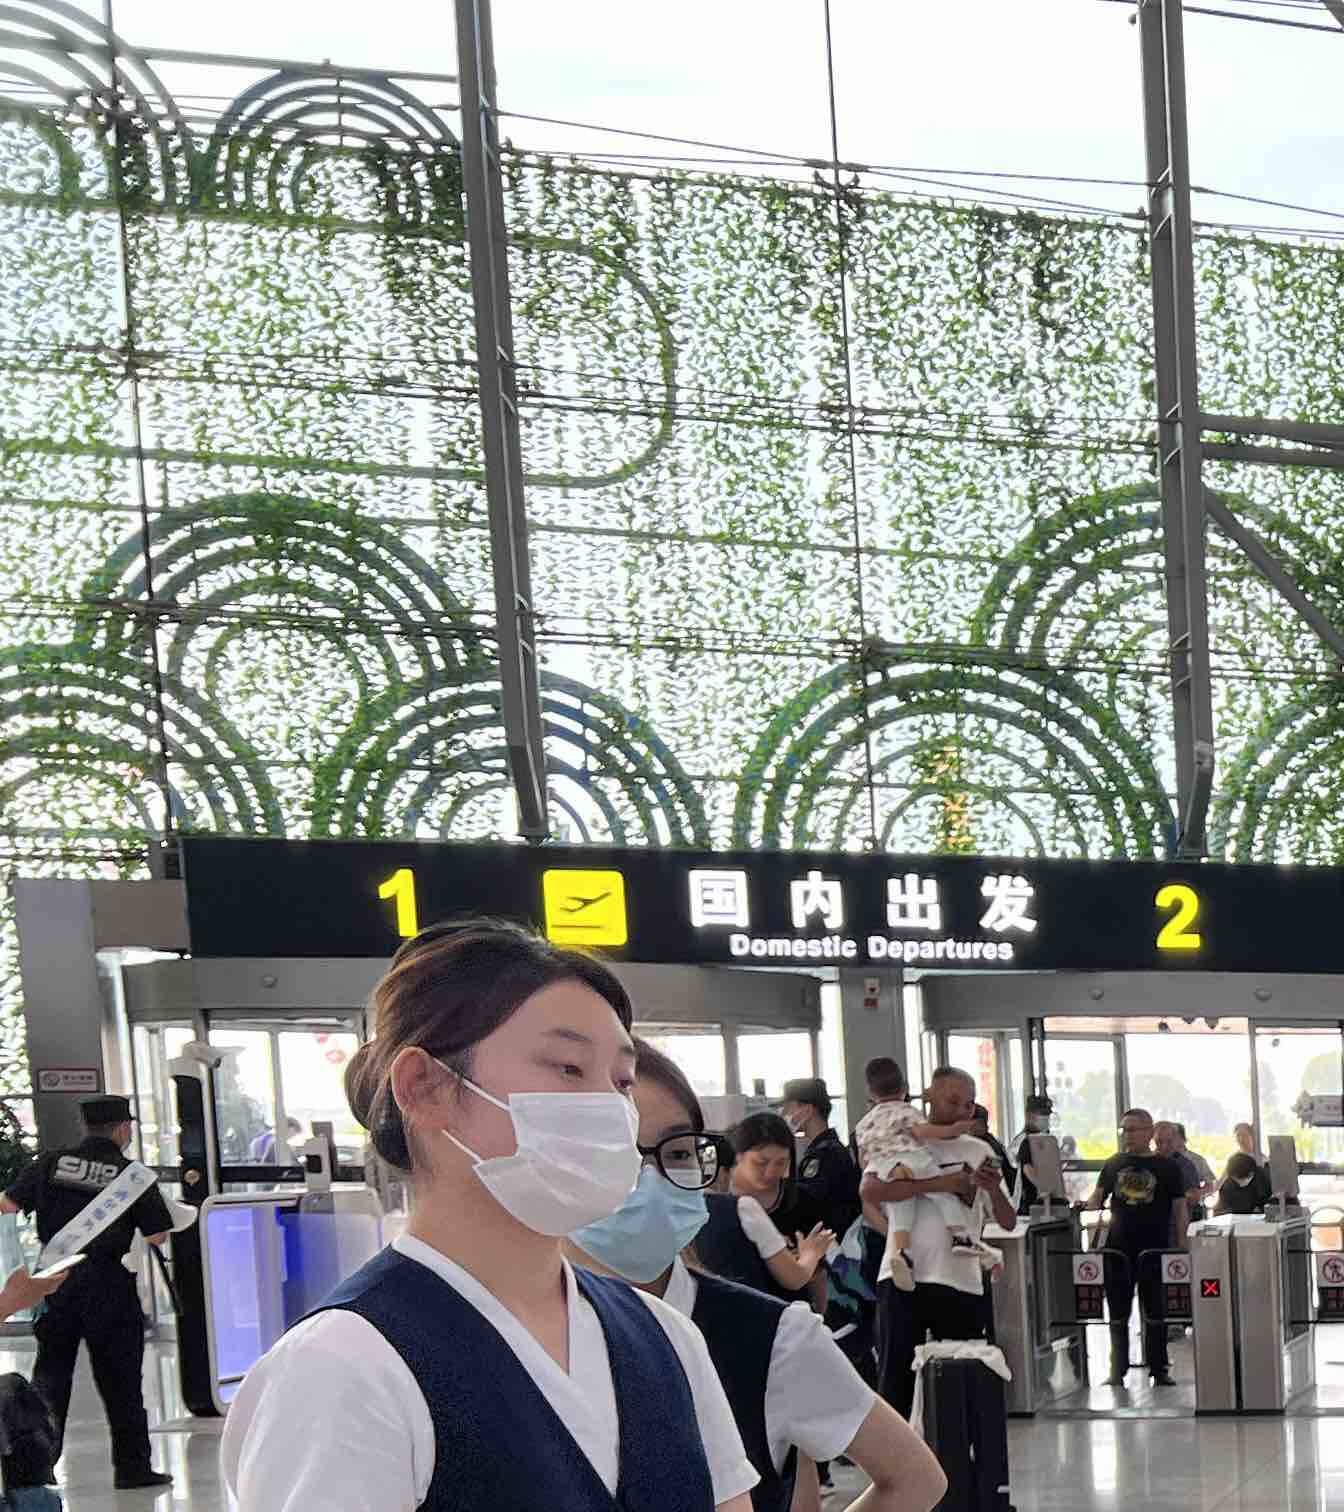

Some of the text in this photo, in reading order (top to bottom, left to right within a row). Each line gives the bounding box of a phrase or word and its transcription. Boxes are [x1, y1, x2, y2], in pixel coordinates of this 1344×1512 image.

[378, 868, 417, 937] 1
[688, 868, 1037, 932] 国内出发
[1155, 884, 1201, 948] 2
[729, 933, 1014, 961] Domestic Departures
